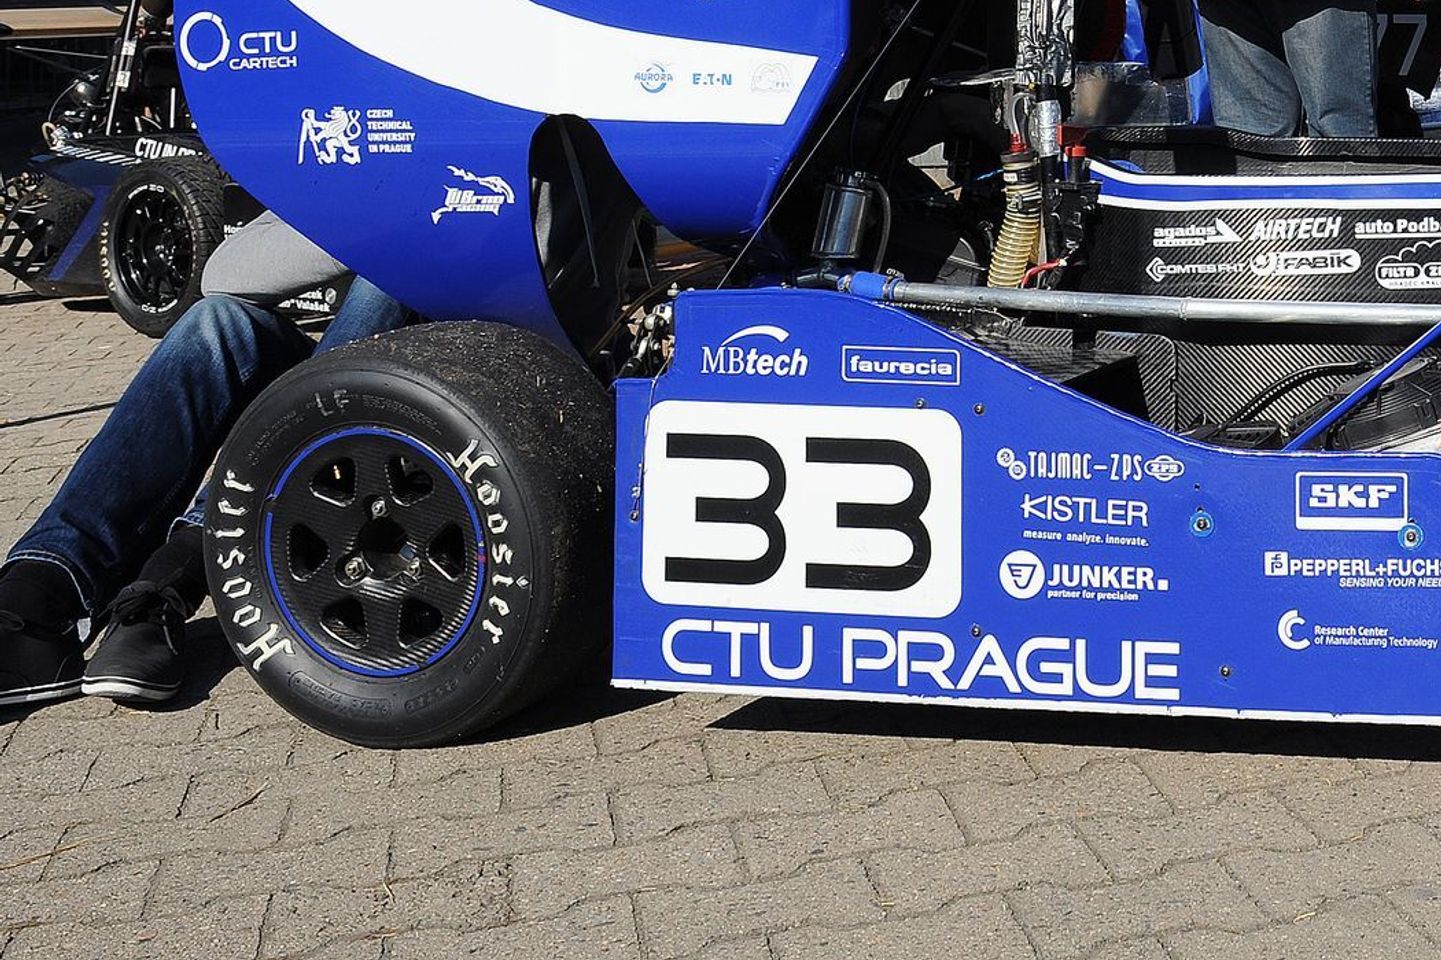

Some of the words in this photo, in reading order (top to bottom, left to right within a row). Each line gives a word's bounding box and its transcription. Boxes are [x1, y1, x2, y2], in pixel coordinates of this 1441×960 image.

[238, 30, 298, 55] CTU
[228, 55, 298, 71] CARTECH
[633, 71, 674, 83] AURORA
[367, 109, 394, 119] CZECH
[367, 121, 413, 131] TECHNICAL
[367, 132, 416, 143] UNIVERSITY
[368, 144, 378, 153] IN
[379, 143, 413, 153] PRAGUE
[1154, 224, 1216, 239] agados
[1250, 216, 1342, 240] AIRTECH
[1354, 219, 1394, 235] auto
[1158, 263, 1215, 274] COMTES
[1380, 266, 1416, 278] FILTR
[700, 346, 808, 377] MBtech
[850, 354, 953, 376] faurecia
[1308, 483, 1397, 509] SKF
[664, 431, 932, 592] 33
[1020, 493, 1149, 527] KISTLER
[446, 439, 531, 644] Hoosier
[1105, 533, 1150, 547] innovate.
[1338, 577, 1384, 588] SENSING
[1386, 577, 1416, 588] YOUR
[1047, 590, 1080, 600] partner
[1081, 590, 1096, 600] for
[1096, 590, 1139, 602] precision
[1314, 625, 1356, 636] Research
[1357, 626, 1389, 637] Center
[1314, 636, 1324, 645] of
[1325, 637, 1388, 648] Manufacturing
[1389, 637, 1439, 649] Technology
[661, 618, 814, 681] CTU
[842, 626, 1181, 701] PRAGUE
